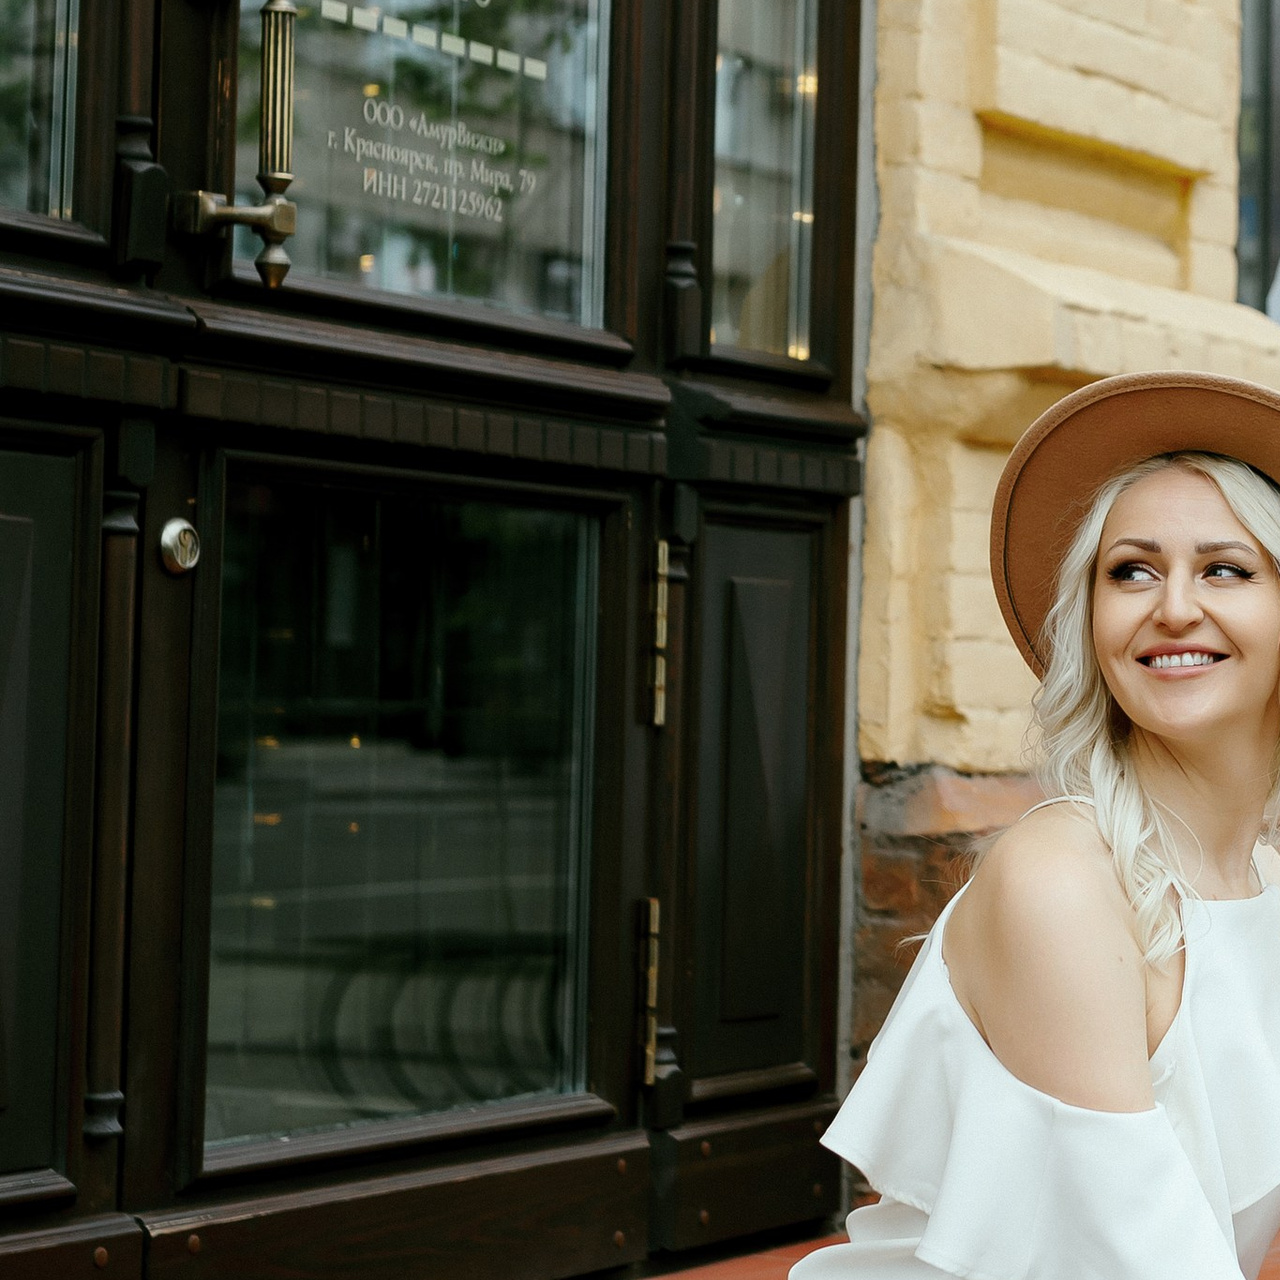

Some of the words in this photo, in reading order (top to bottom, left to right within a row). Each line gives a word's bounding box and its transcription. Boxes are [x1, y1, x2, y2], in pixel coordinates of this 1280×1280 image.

[363, 98, 404, 130] ООО
[327, 129, 338, 150] г.
[344, 126, 438, 175] Красноярск,
[443, 157, 466, 185] пр.
[470, 158, 514, 195] Мира,
[518, 168, 537, 195] 79
[363, 166, 407, 201] ИНН
[412, 179, 503, 223] 2721125962
